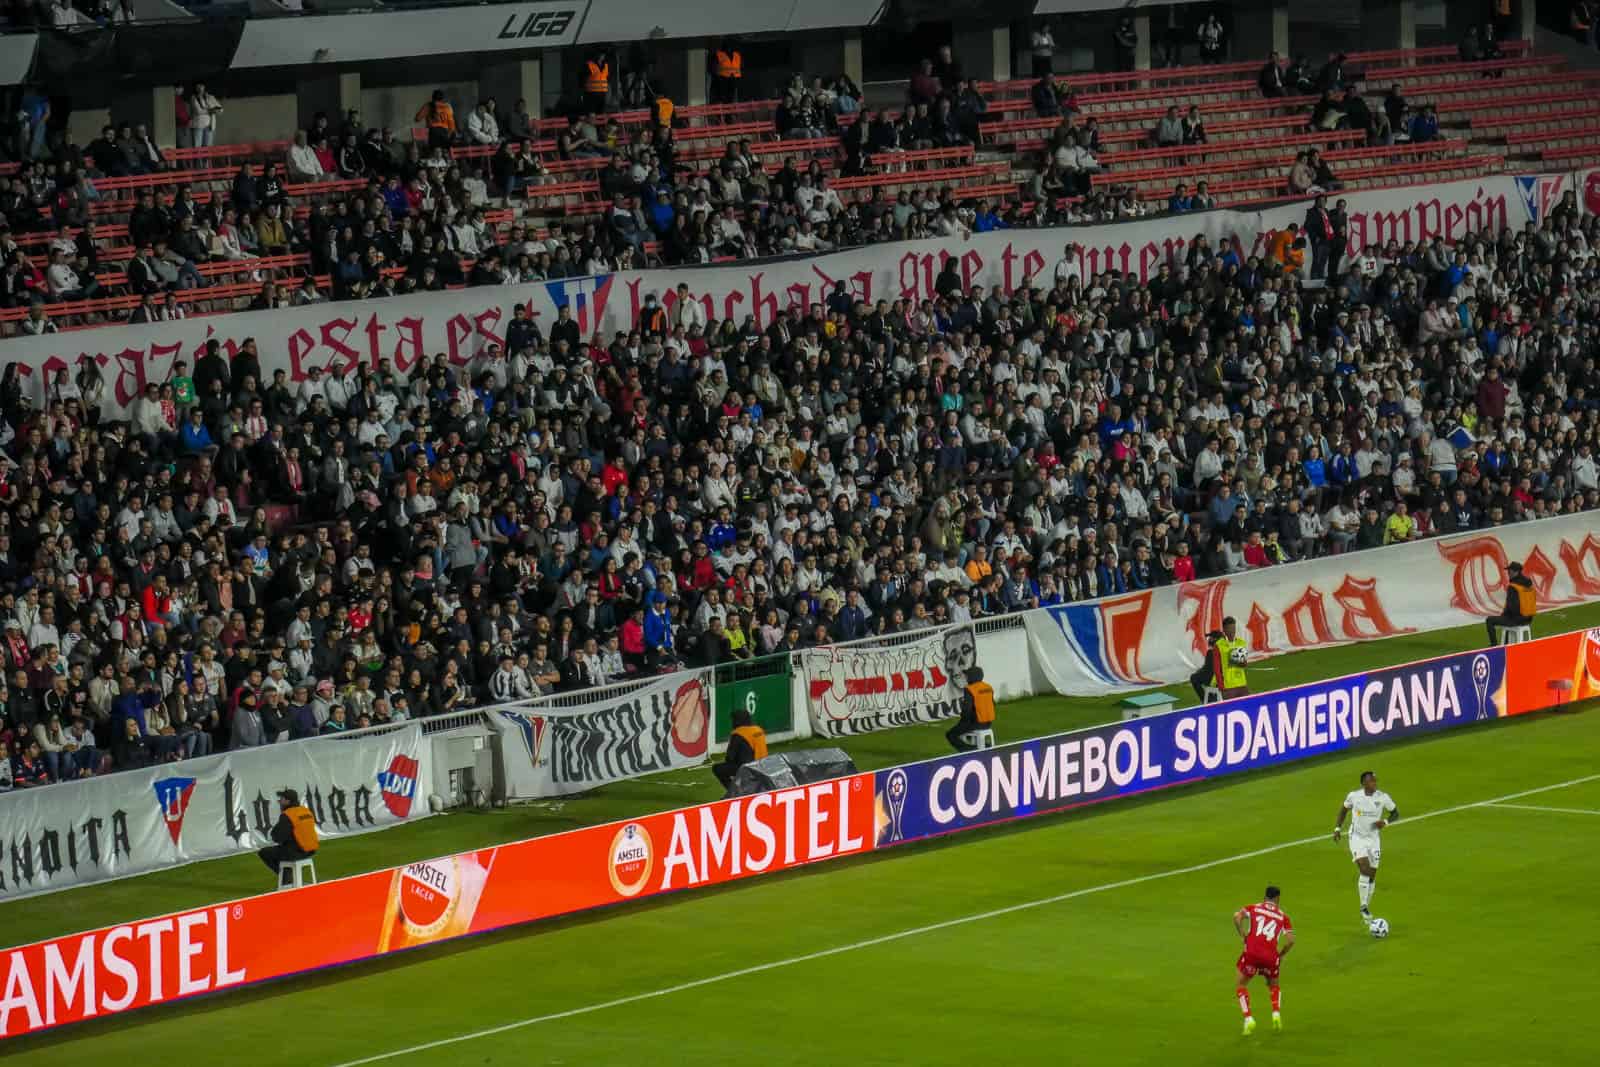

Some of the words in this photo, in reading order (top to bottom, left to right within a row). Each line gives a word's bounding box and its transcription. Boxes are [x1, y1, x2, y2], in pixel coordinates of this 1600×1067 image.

[1346, 186, 1509, 258] ampeón
[745, 691, 756, 714] 6
[929, 727, 1162, 824] CONMEBOL
[1174, 666, 1462, 773] SUDAMERICANA
[0, 809, 131, 892] NDITA
[224, 770, 376, 848] LOURA
[660, 779, 864, 889] AMSTEL
[0, 906, 245, 1037] AMSTEL
[1256, 915, 1277, 941] 14
